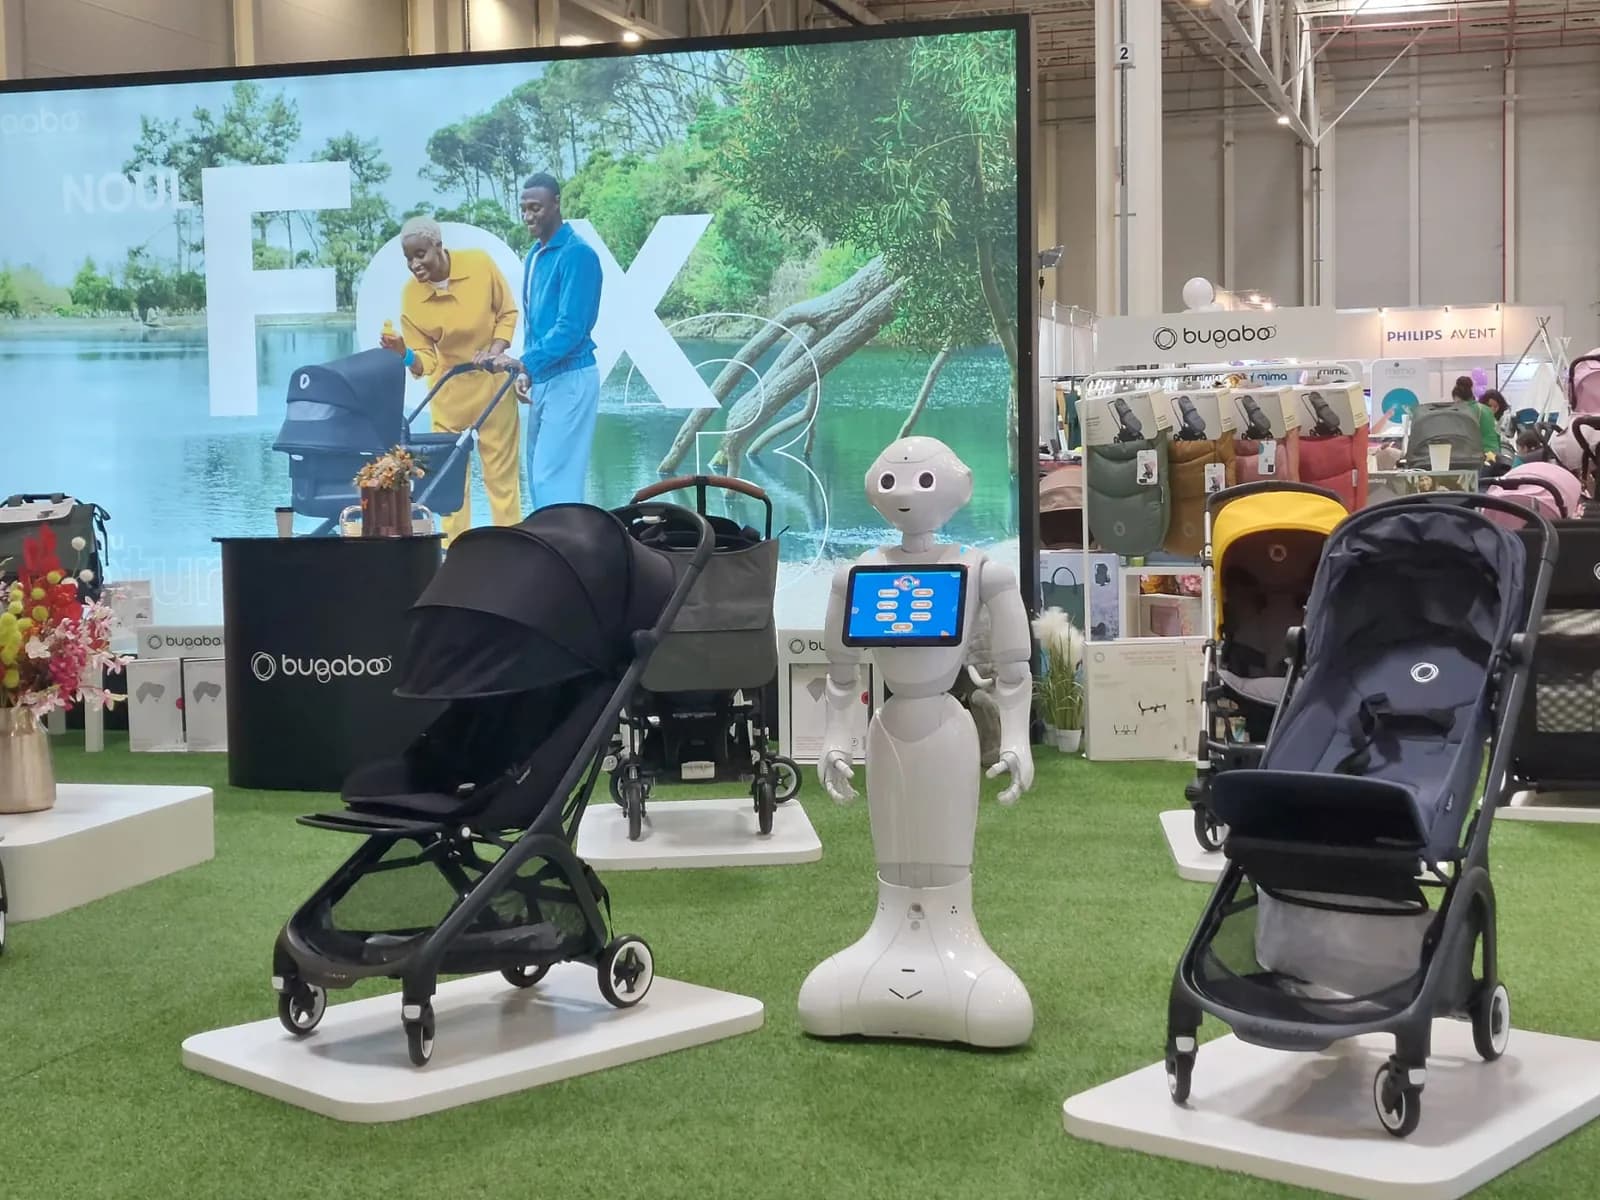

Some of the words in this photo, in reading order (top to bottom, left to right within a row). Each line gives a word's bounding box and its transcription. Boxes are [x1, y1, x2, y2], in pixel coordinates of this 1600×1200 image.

[1119, 47, 1129, 60] 2
[62, 167, 195, 215] NOUL
[1183, 325, 1277, 349] bugaboo
[1386, 329, 1442, 342] PHILIPS
[1450, 327, 1496, 340] AVENT
[1257, 372, 1288, 381] mima
[281, 654, 393, 684] bugaboo
